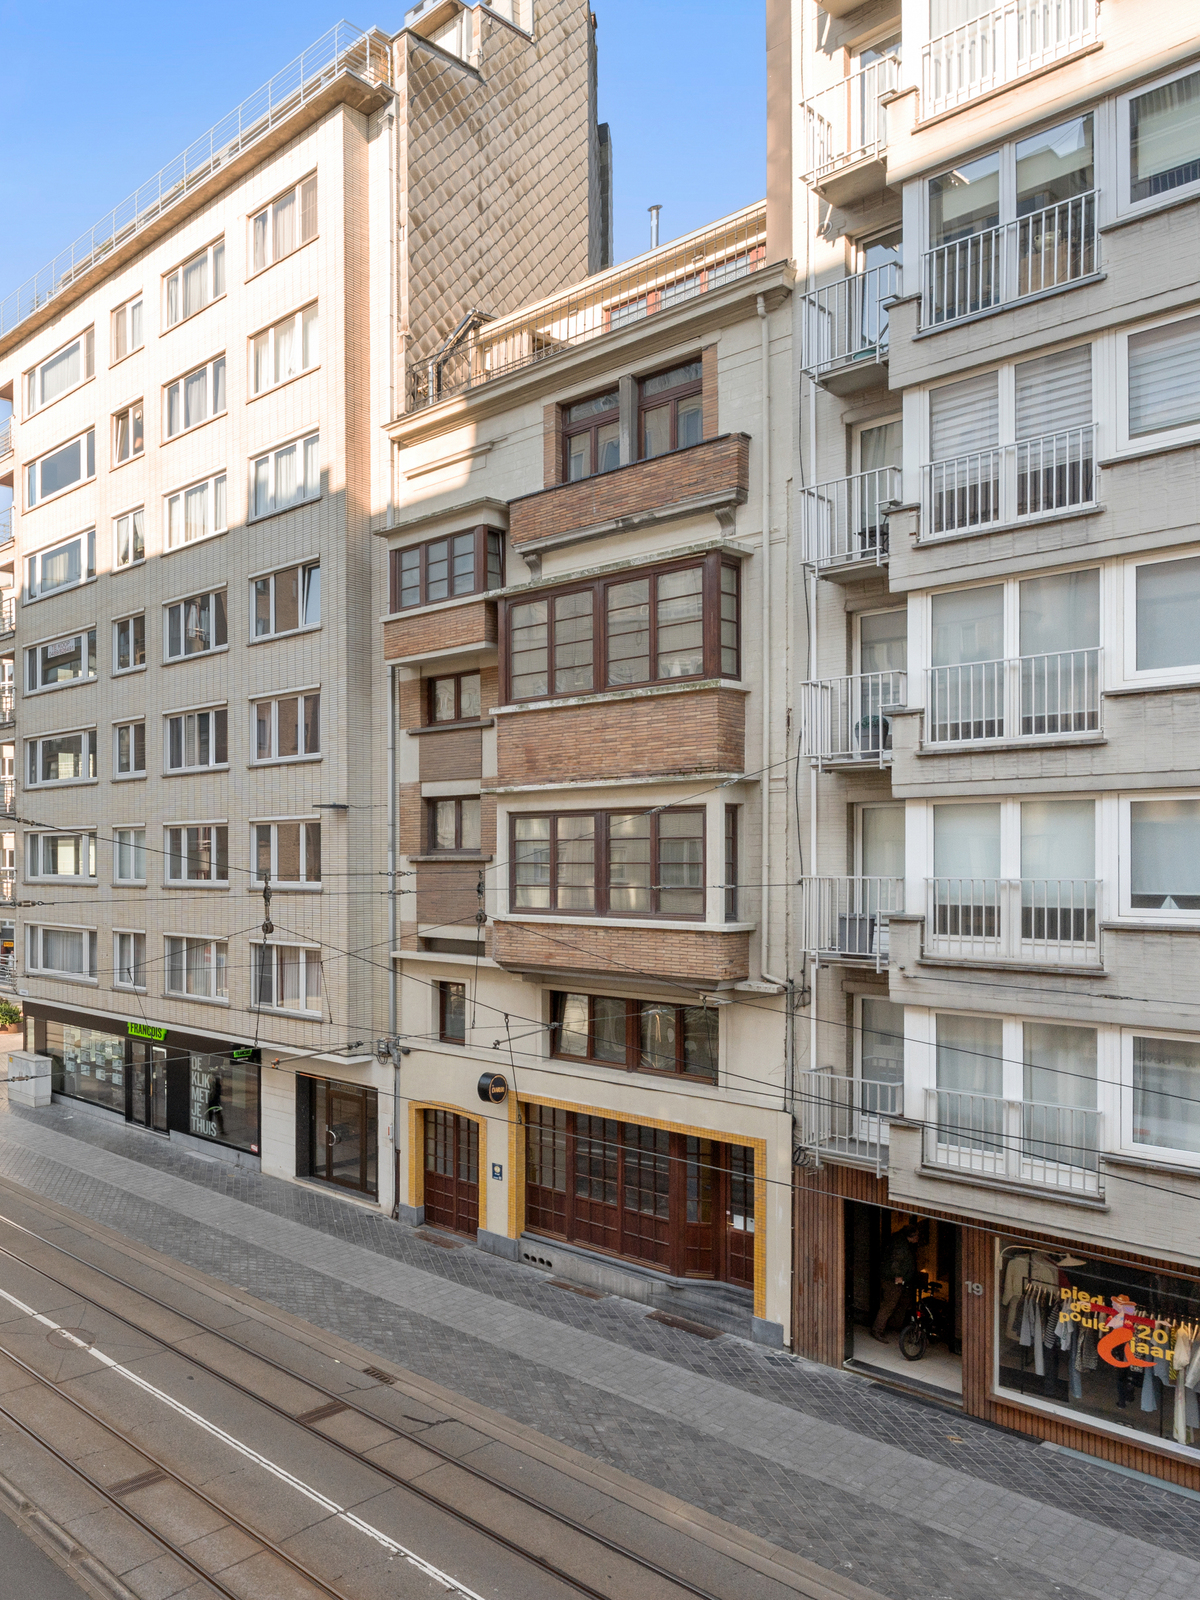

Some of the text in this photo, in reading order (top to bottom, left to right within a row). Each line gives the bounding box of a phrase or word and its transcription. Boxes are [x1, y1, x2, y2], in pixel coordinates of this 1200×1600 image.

[191, 1056, 203, 1072] DE
[191, 1071, 210, 1089] KLIK
[191, 1086, 210, 1104] MET
[191, 1101, 202, 1117] JE
[191, 1116, 217, 1137] THUIS
[964, 1280, 983, 1296] 19
[1060, 1286, 1103, 1306] pied
[1070, 1300, 1091, 1313] de
[1059, 1311, 1110, 1332] poule
[1137, 1325, 1169, 1345] 20
[1130, 1337, 1176, 1361] jaar
